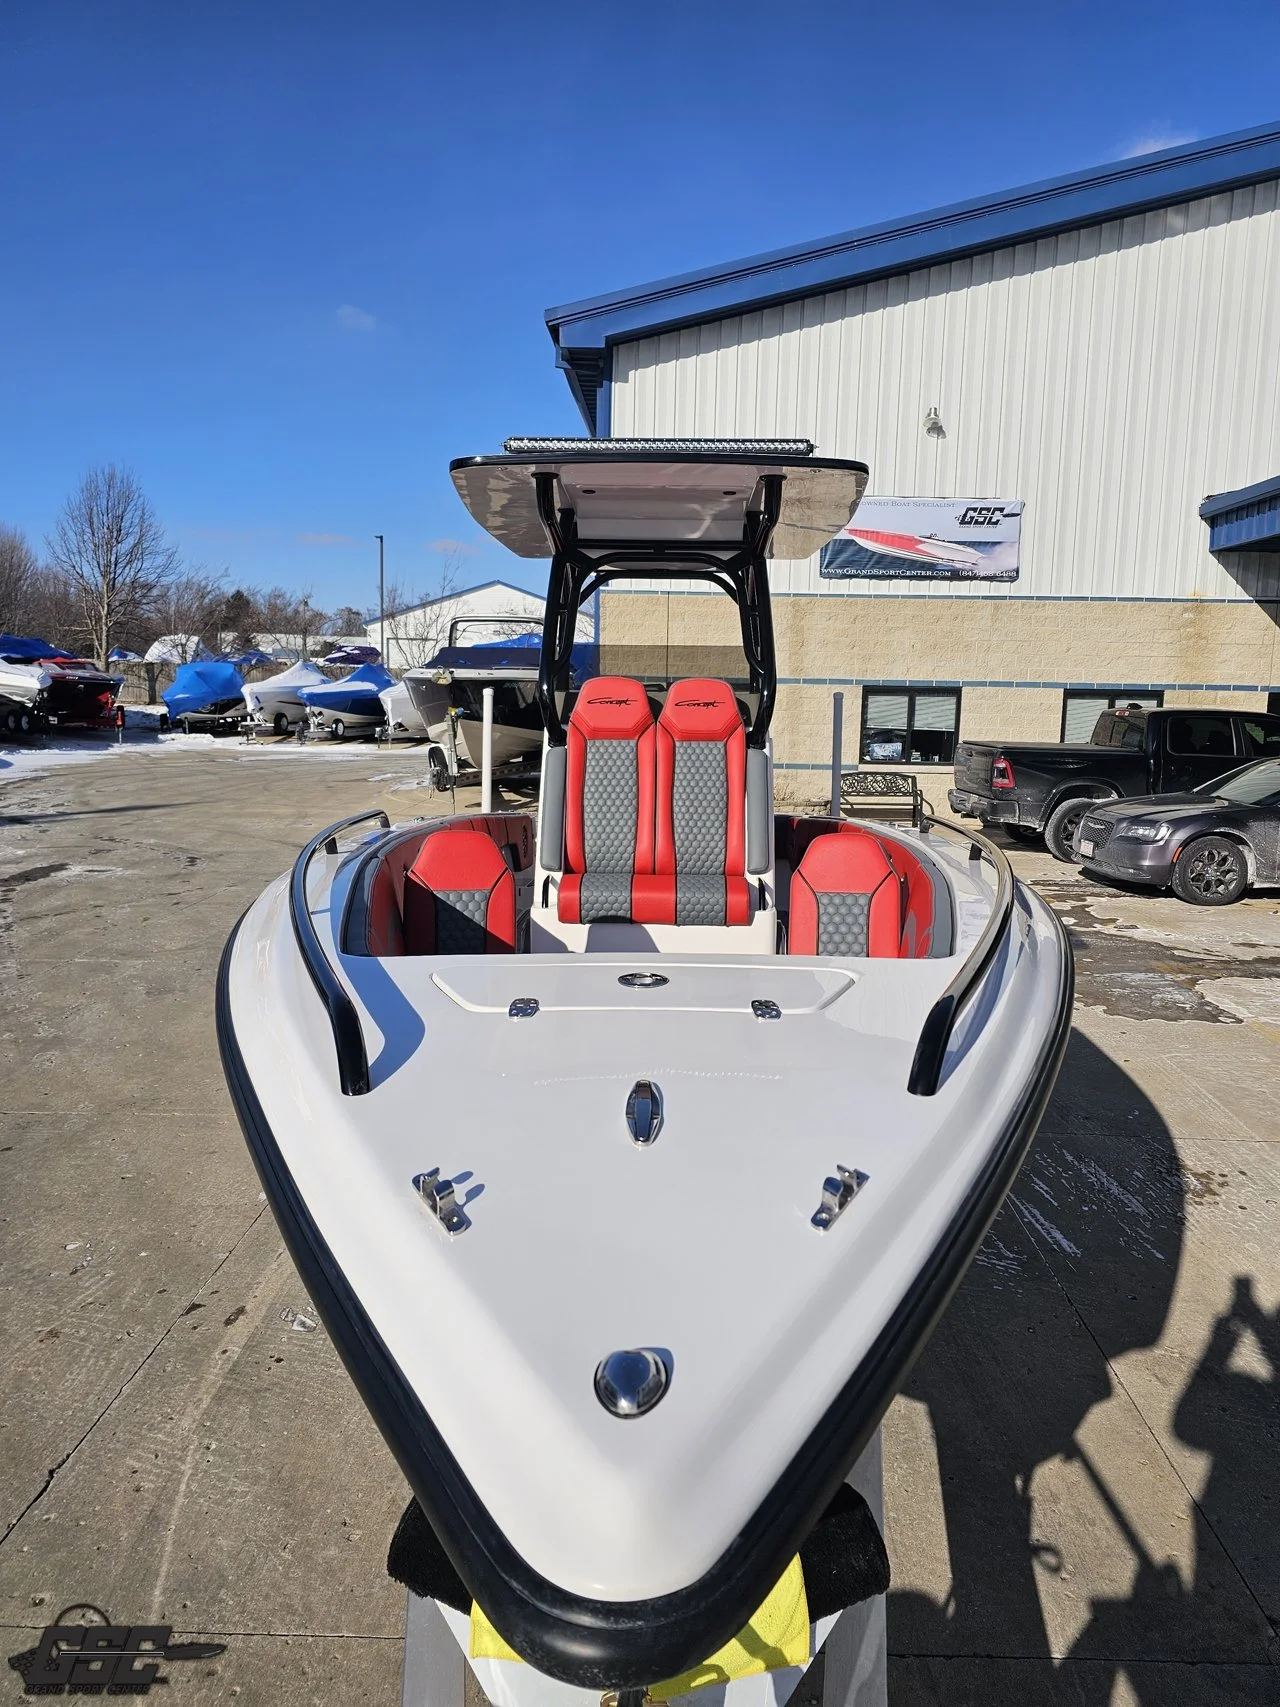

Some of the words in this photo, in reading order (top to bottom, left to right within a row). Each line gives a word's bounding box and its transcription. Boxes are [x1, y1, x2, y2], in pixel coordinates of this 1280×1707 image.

[959, 507, 1006, 525] GSC
[586, 697, 638, 708] Concept
[674, 699, 726, 710] Concept
